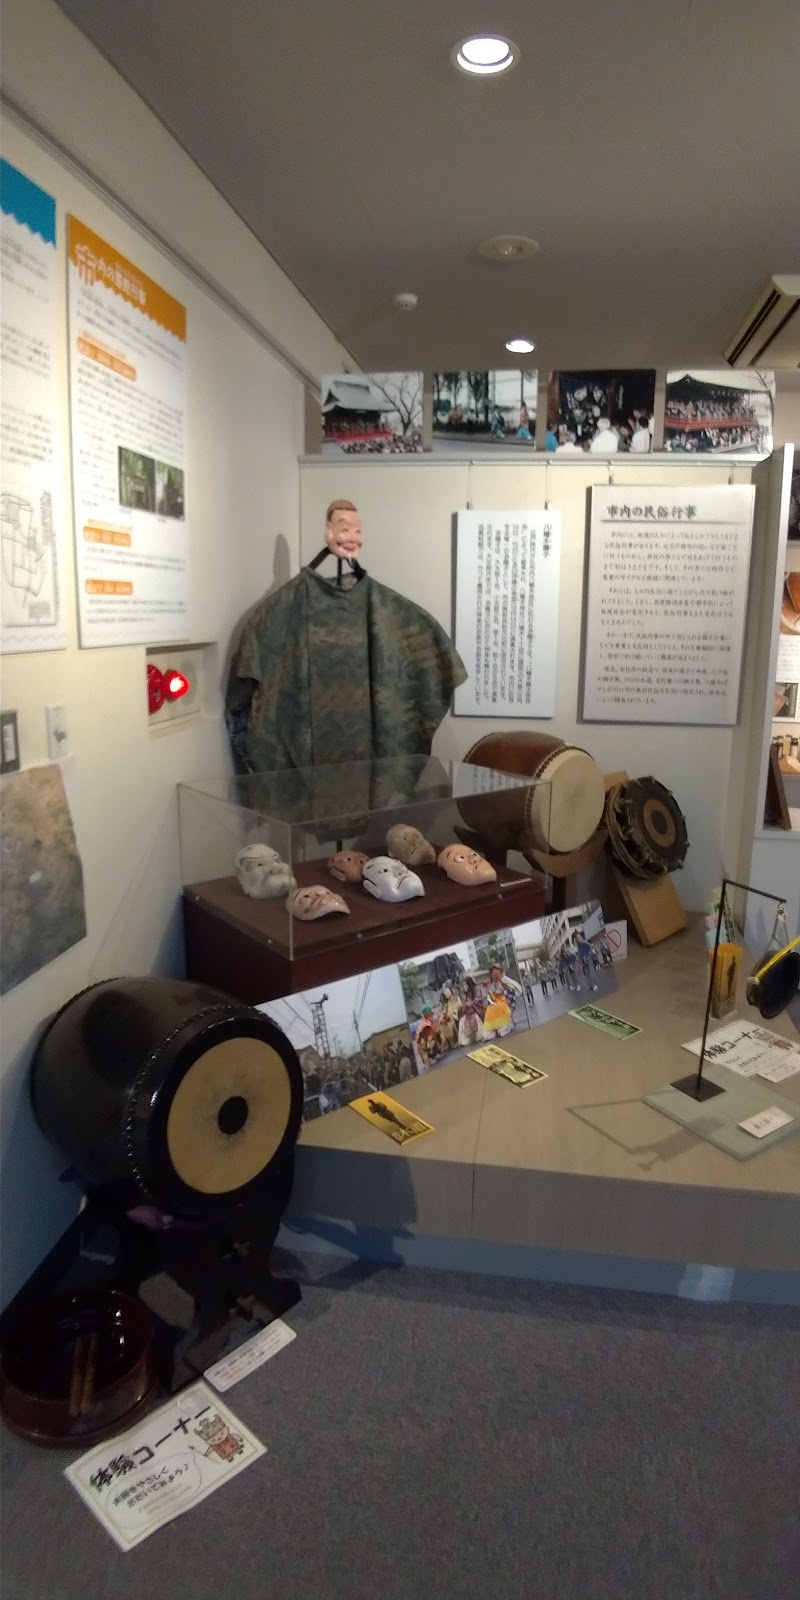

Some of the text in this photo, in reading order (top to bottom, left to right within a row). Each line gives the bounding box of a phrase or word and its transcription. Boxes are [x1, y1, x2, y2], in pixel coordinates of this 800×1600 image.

[606, 504, 697, 520] 市内の民俗行事
[89, 1405, 211, 1493] 体験コーナー
